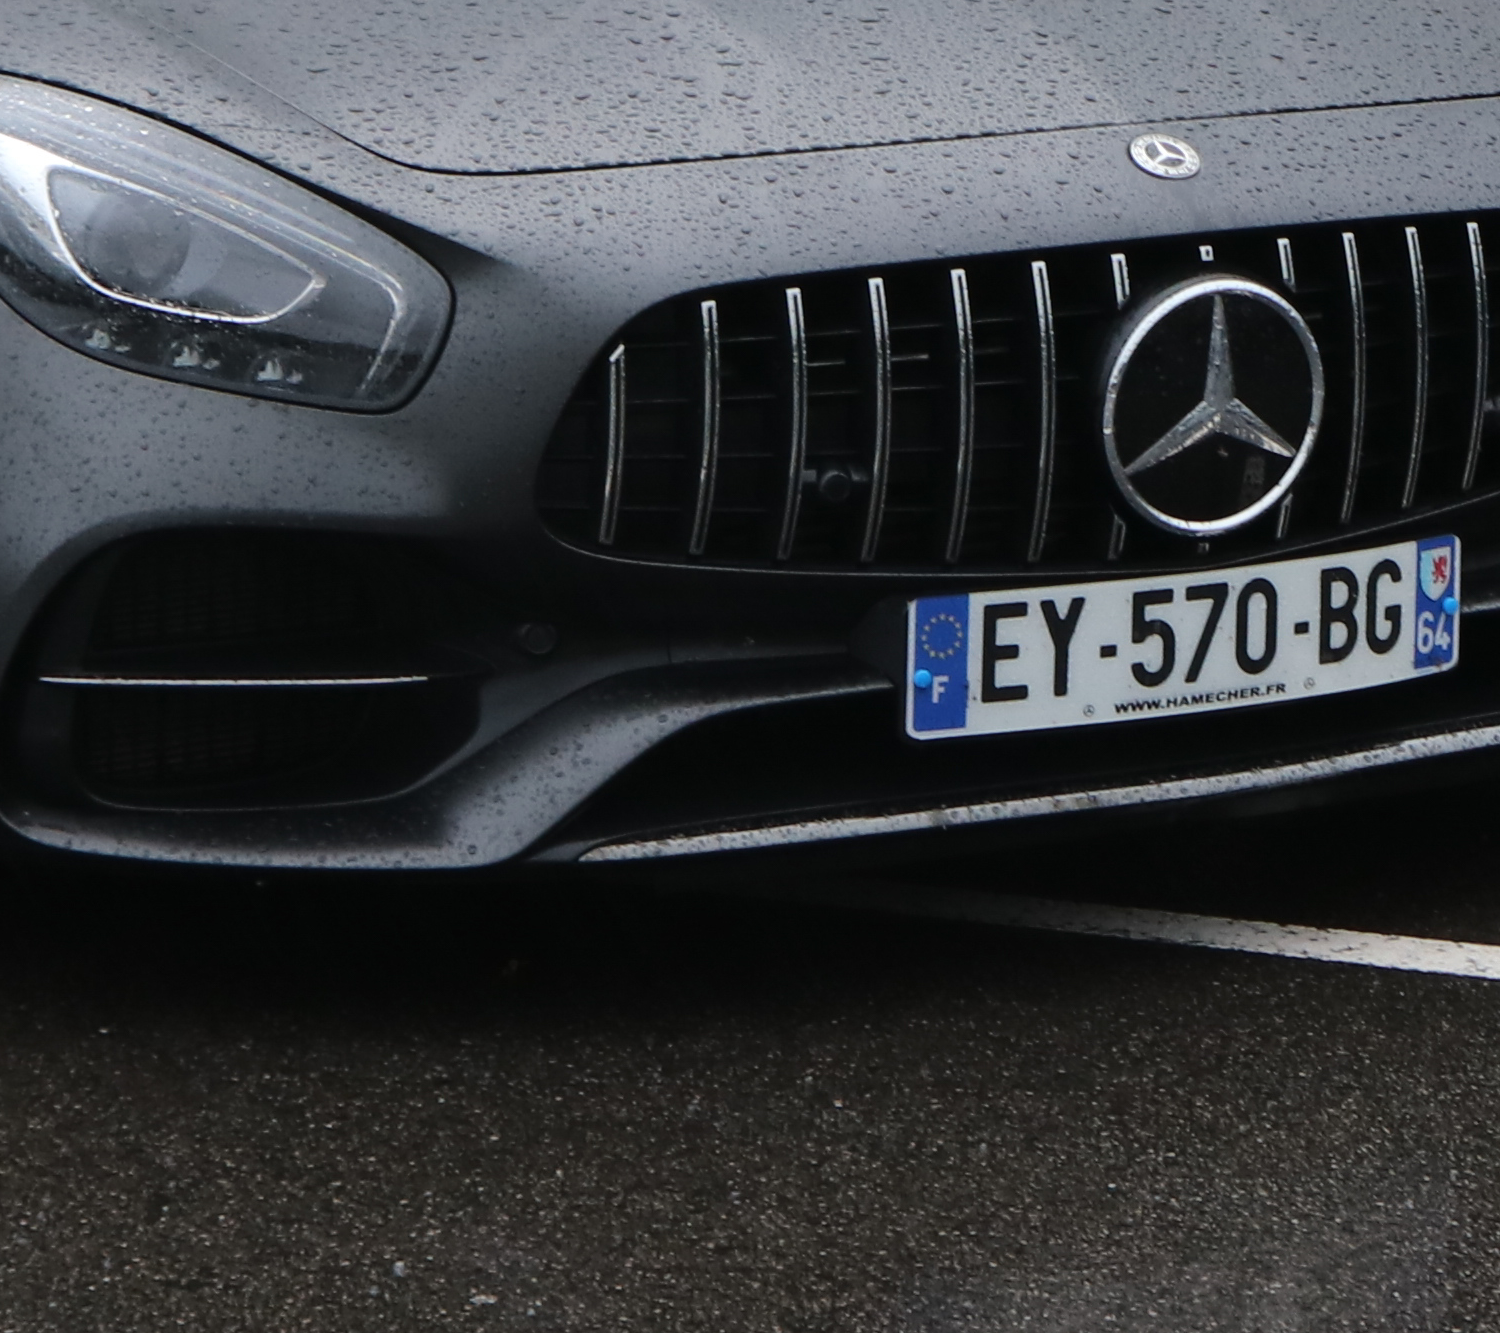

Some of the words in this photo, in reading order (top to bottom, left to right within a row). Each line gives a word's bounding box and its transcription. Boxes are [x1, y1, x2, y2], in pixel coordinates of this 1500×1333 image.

[931, 675, 949, 704] F
[981, 558, 1403, 704] EY-570-BG
[1416, 610, 1452, 654] 64
[1114, 683, 1287, 714] WWW.HAMECHER.FR
